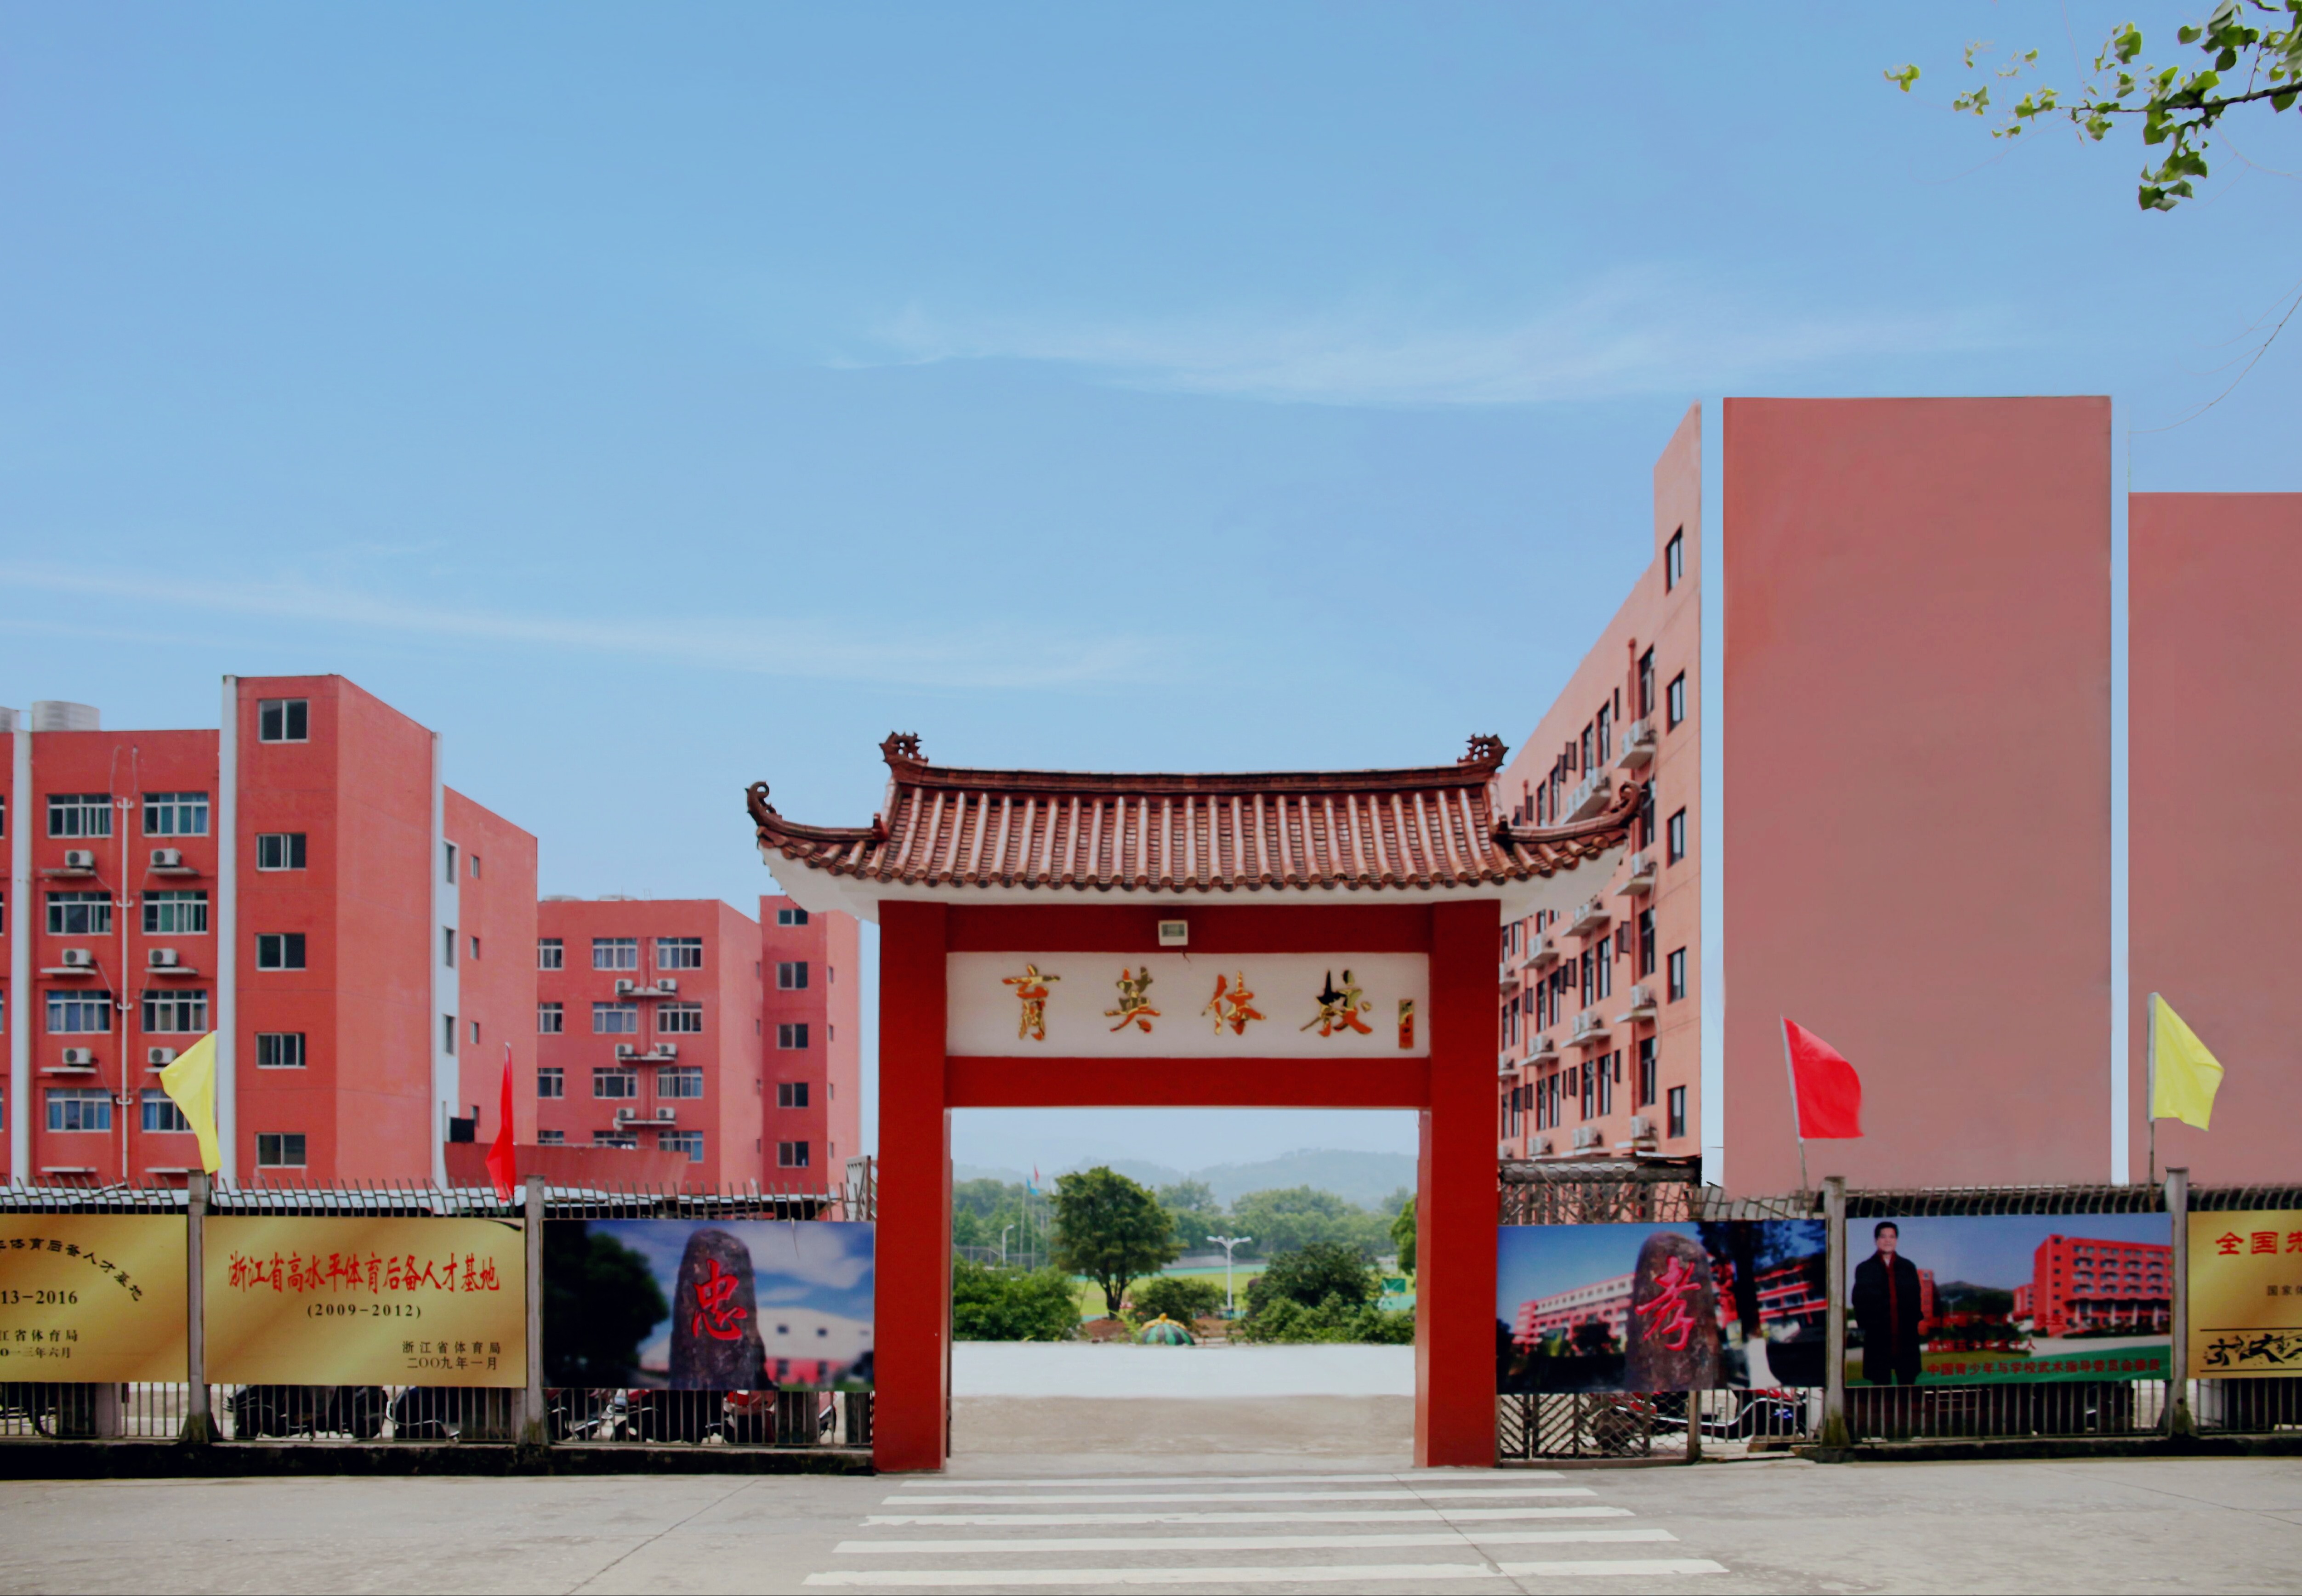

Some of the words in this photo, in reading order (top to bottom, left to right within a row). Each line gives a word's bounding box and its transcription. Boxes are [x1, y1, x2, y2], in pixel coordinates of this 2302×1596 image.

[1002, 964, 1372, 1041] 育英体校
[229, 1250, 500, 1294] 浙江省高水平体育后备人才基地
[692, 1258, 748, 1340] 忠
[307, 1303, 421, 1318] (2009-2012)
[1635, 1255, 1701, 1351] 孝
[402, 1340, 501, 1355] 浙江省体育局
